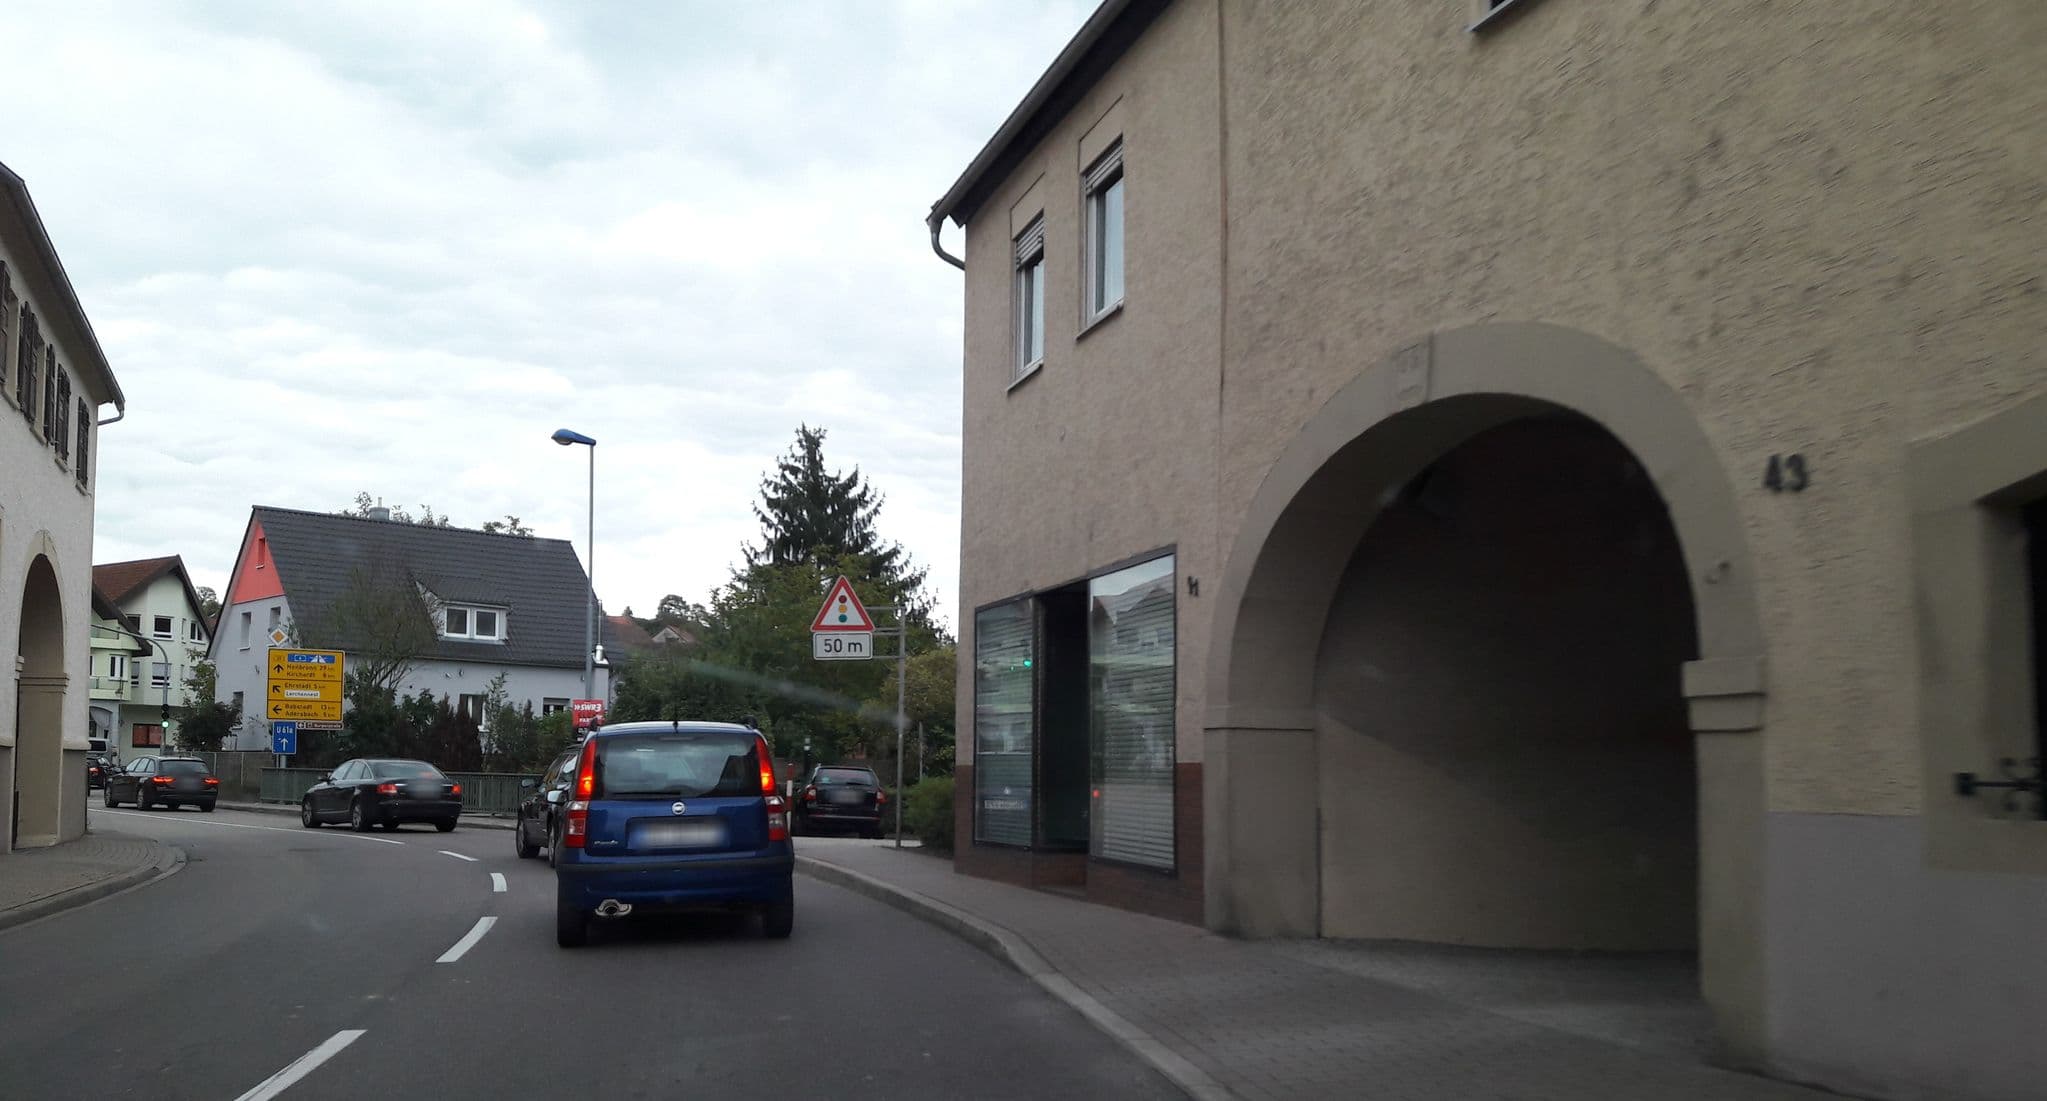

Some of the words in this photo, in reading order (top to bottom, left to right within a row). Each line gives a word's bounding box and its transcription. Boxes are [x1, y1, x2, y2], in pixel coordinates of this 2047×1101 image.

[1764, 452, 1808, 493] 43
[824, 638, 843, 653] 50
[848, 641, 863, 653] m
[276, 726, 281, 734] U
